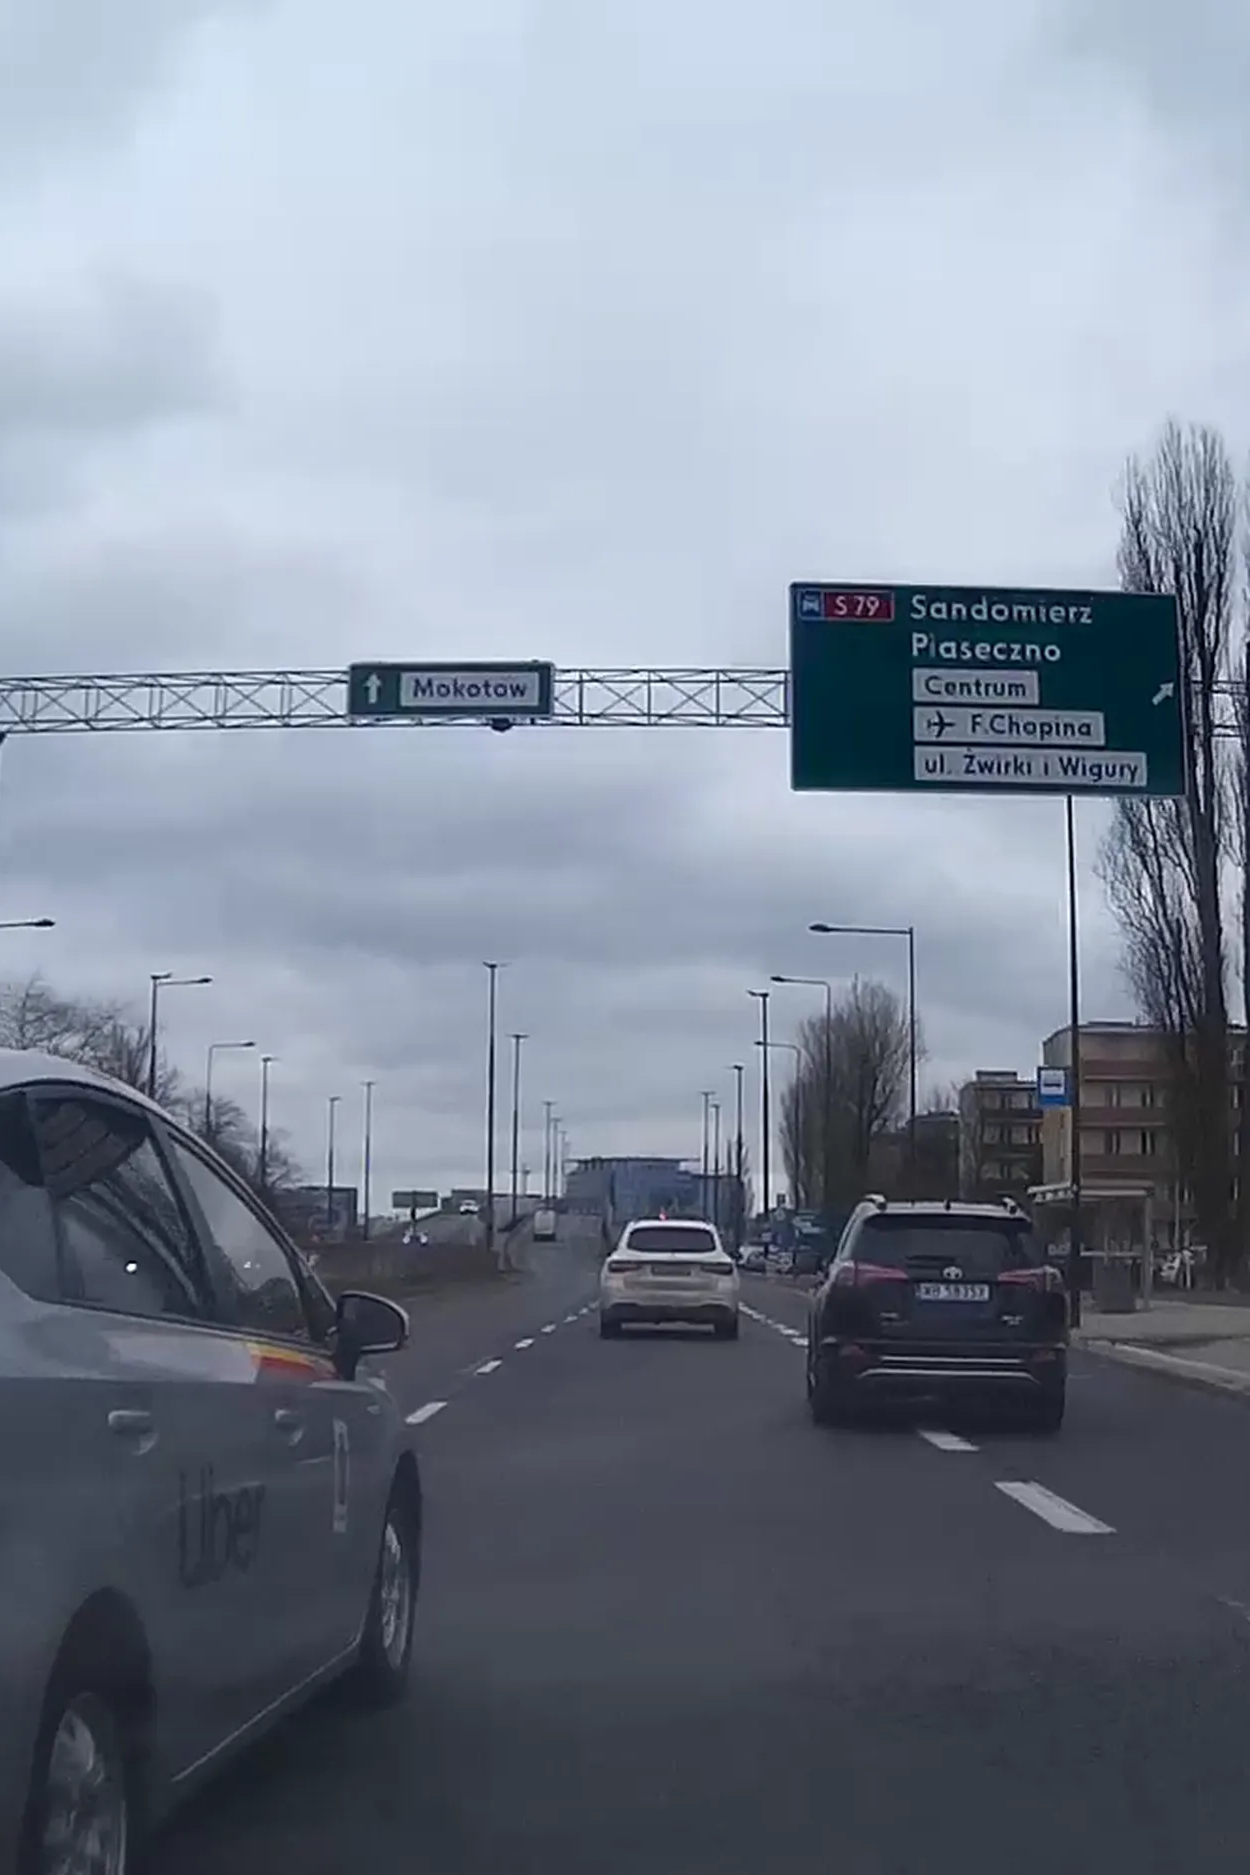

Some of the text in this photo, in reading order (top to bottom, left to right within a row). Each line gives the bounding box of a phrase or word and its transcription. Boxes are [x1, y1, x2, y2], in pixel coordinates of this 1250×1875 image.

[910, 595, 1093, 625] Sandomierz
[911, 632, 1062, 662] Piaseczno
[924, 675, 1027, 699] Centrum
[925, 754, 951, 776] ul.
[1058, 757, 1140, 784] Wigury
